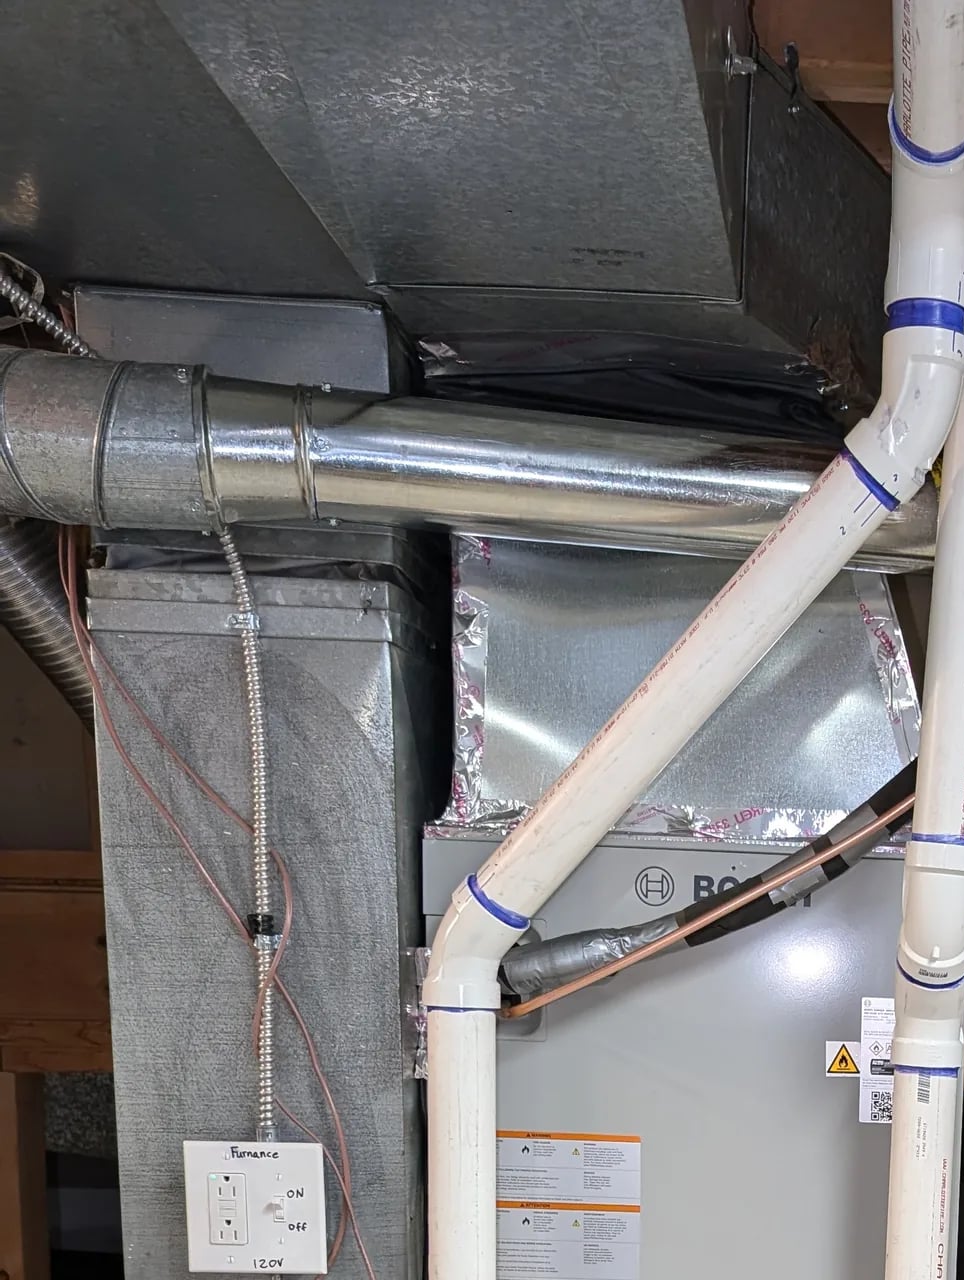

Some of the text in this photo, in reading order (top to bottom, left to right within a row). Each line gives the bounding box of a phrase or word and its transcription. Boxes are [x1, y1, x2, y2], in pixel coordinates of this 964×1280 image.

[230, 1146, 280, 1159] Furnance
[287, 1188, 304, 1198] ON
[254, 1258, 284, 1269] 120V
